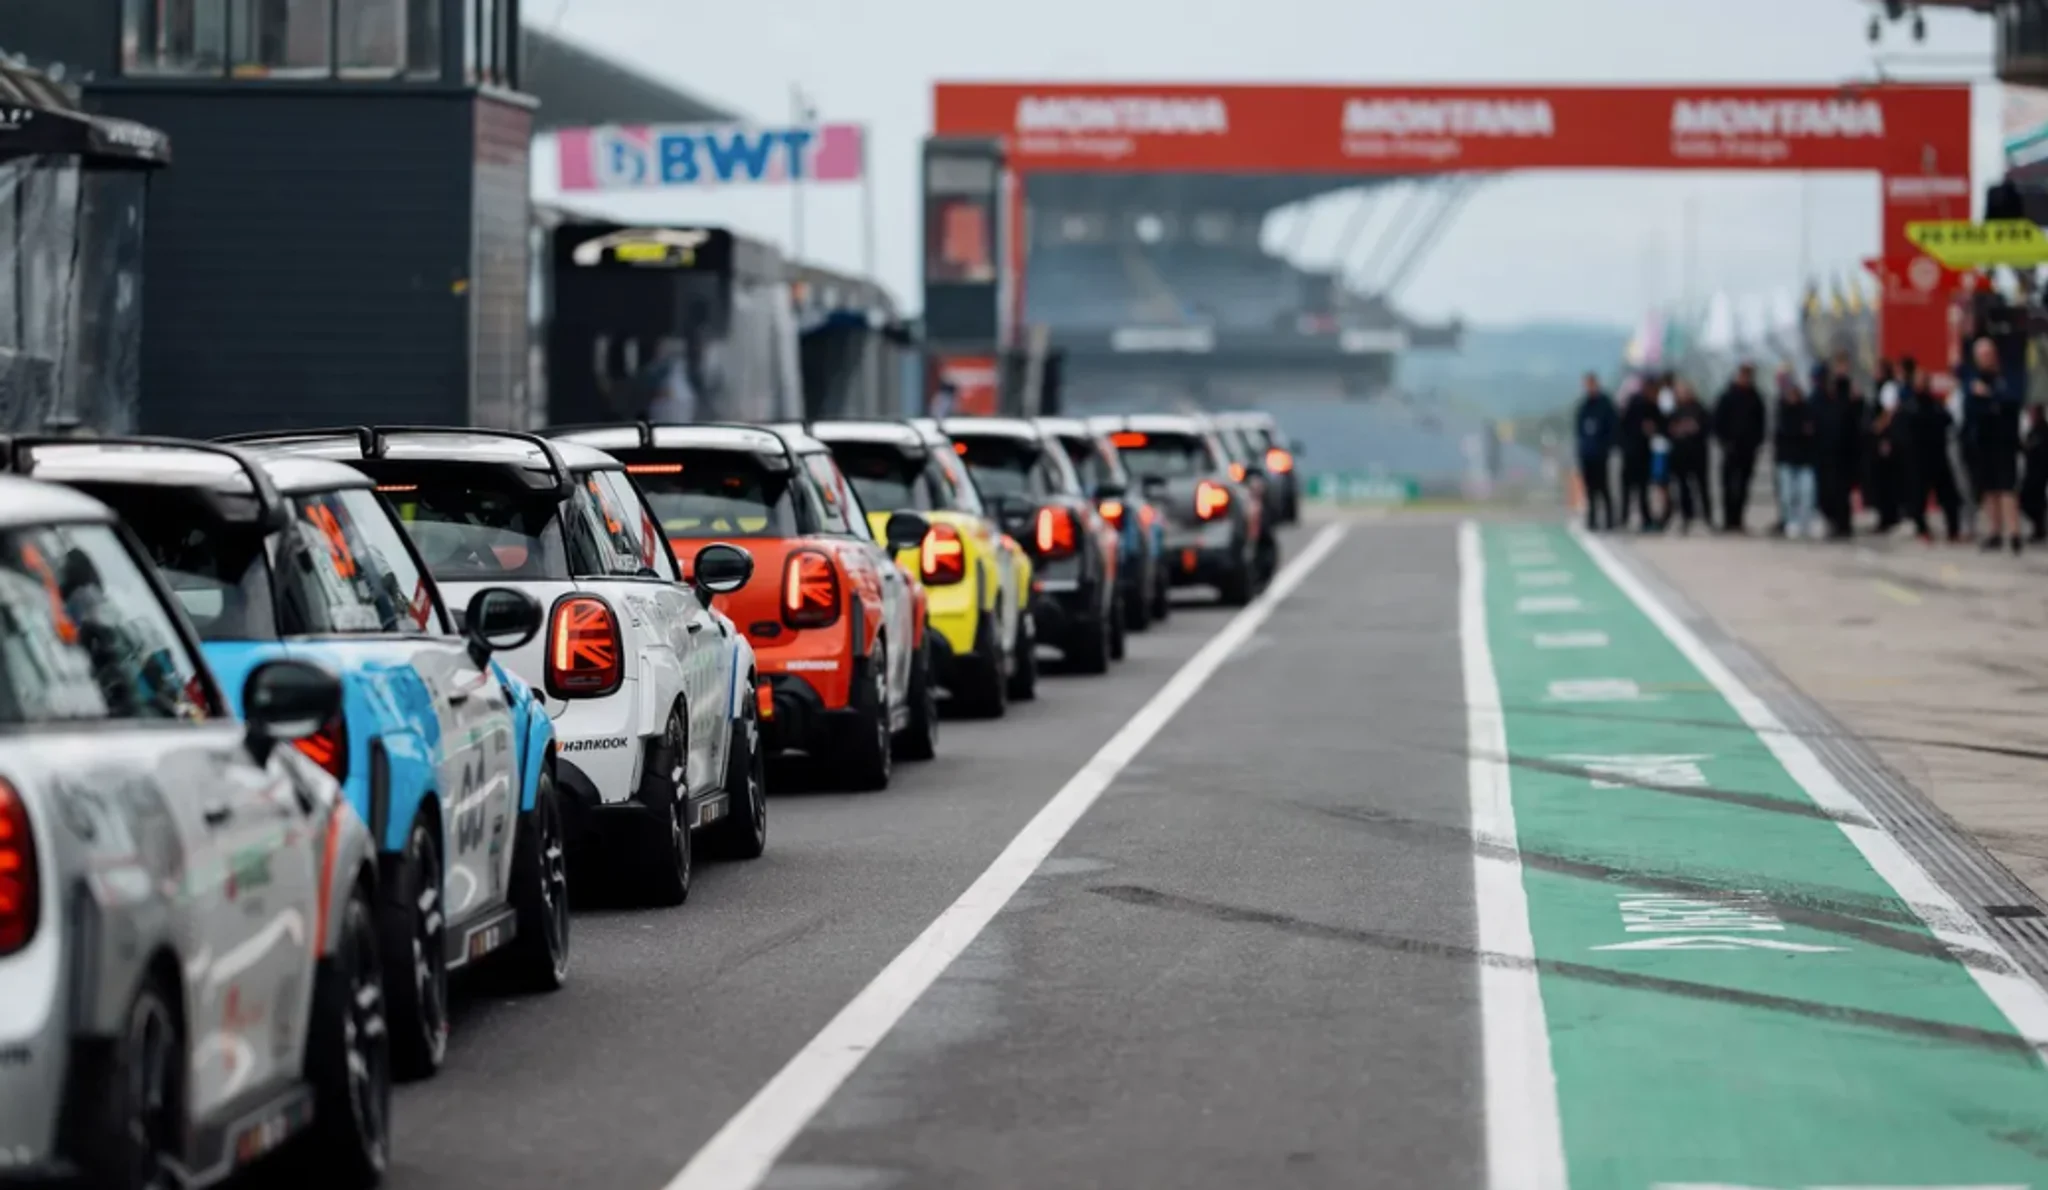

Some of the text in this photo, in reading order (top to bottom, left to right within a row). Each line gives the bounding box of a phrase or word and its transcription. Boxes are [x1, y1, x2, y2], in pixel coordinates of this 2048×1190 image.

[1017, 96, 1228, 134] MONTANA
[1343, 98, 1554, 136] MONTANA
[1671, 99, 1884, 138] MONTANA
[660, 130, 812, 183] BWT
